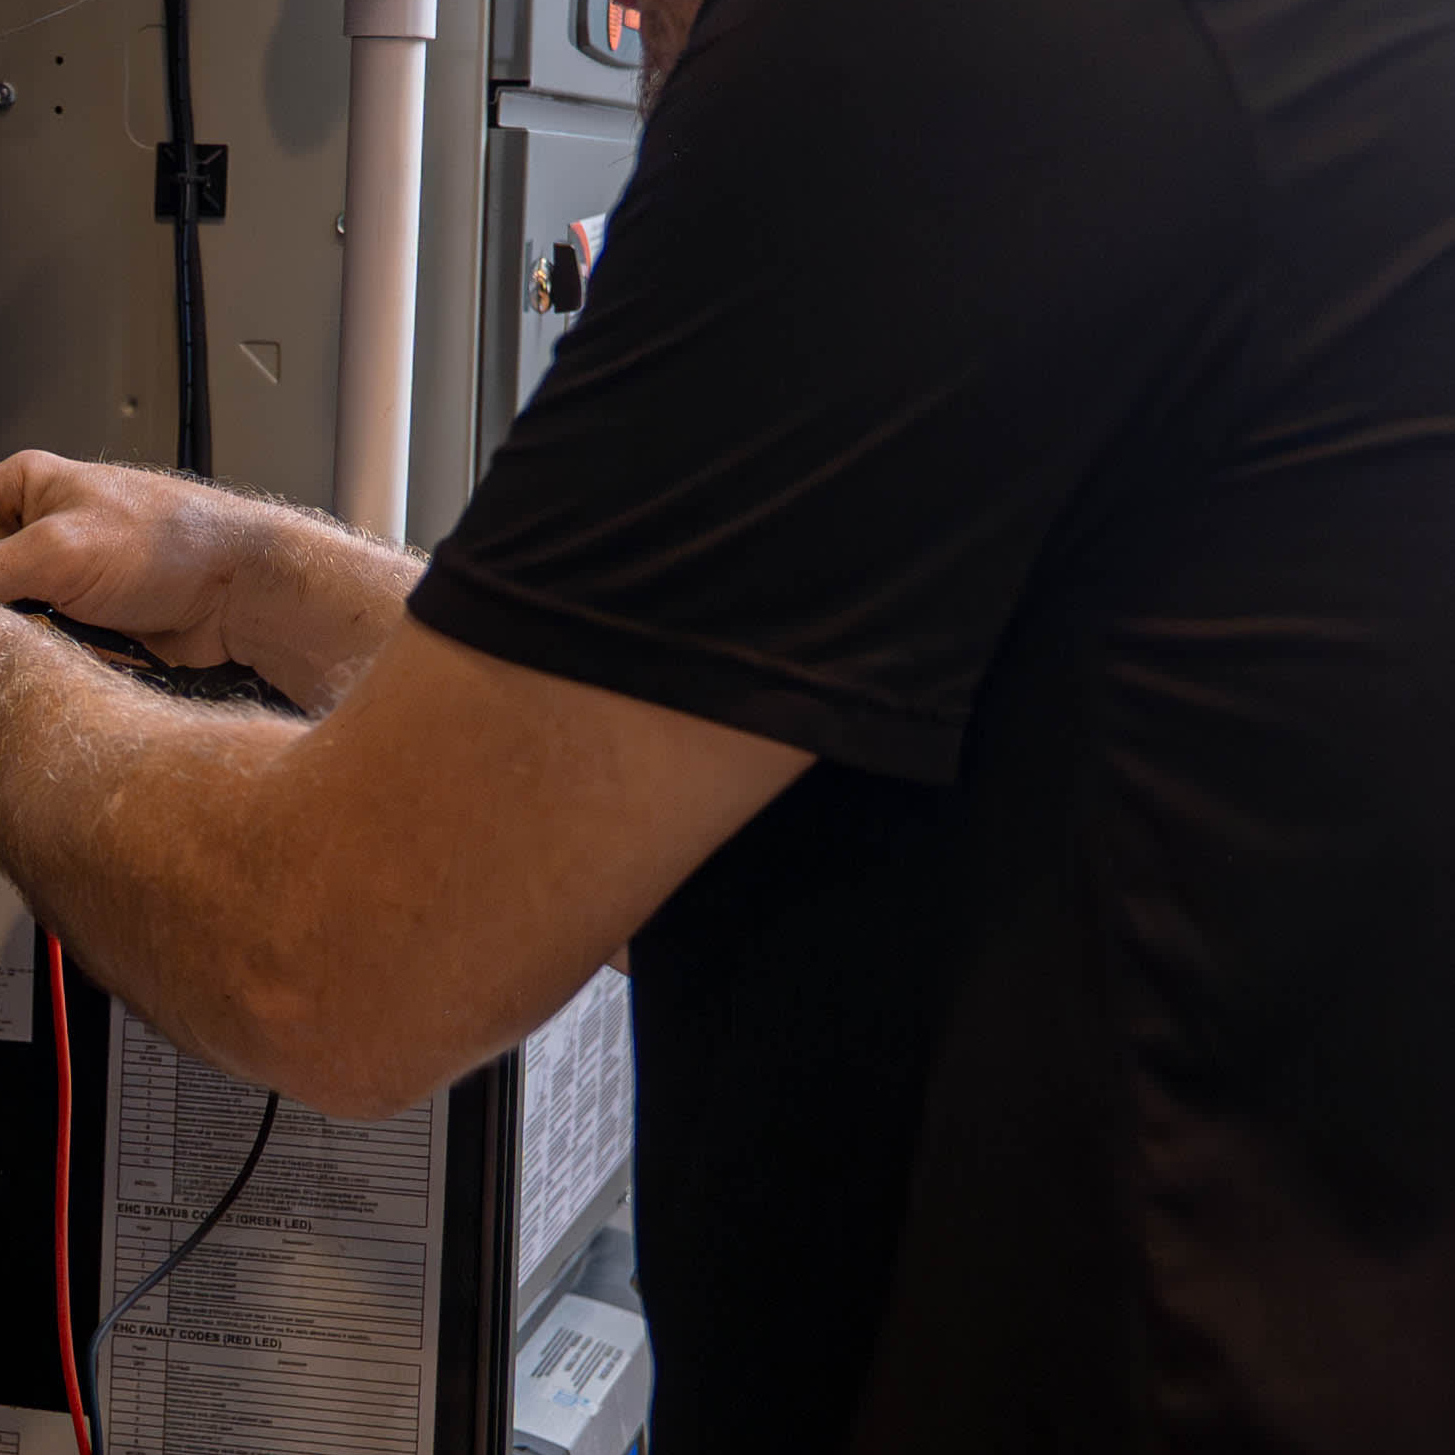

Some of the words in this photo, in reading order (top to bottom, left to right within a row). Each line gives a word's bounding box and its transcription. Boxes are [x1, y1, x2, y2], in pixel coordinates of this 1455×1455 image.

[117, 1203, 141, 1215] EHC
[144, 1205, 188, 1219] STATUS
[191, 1209, 233, 1223] COS
[235, 1214, 282, 1228] (GREEN
[284, 1219, 312, 1232] LED)
[140, 1326, 177, 1339] FAULT
[180, 1329, 220, 1342] CODES
[223, 1333, 252, 1346] (RED
[255, 1336, 283, 1350] LED)
